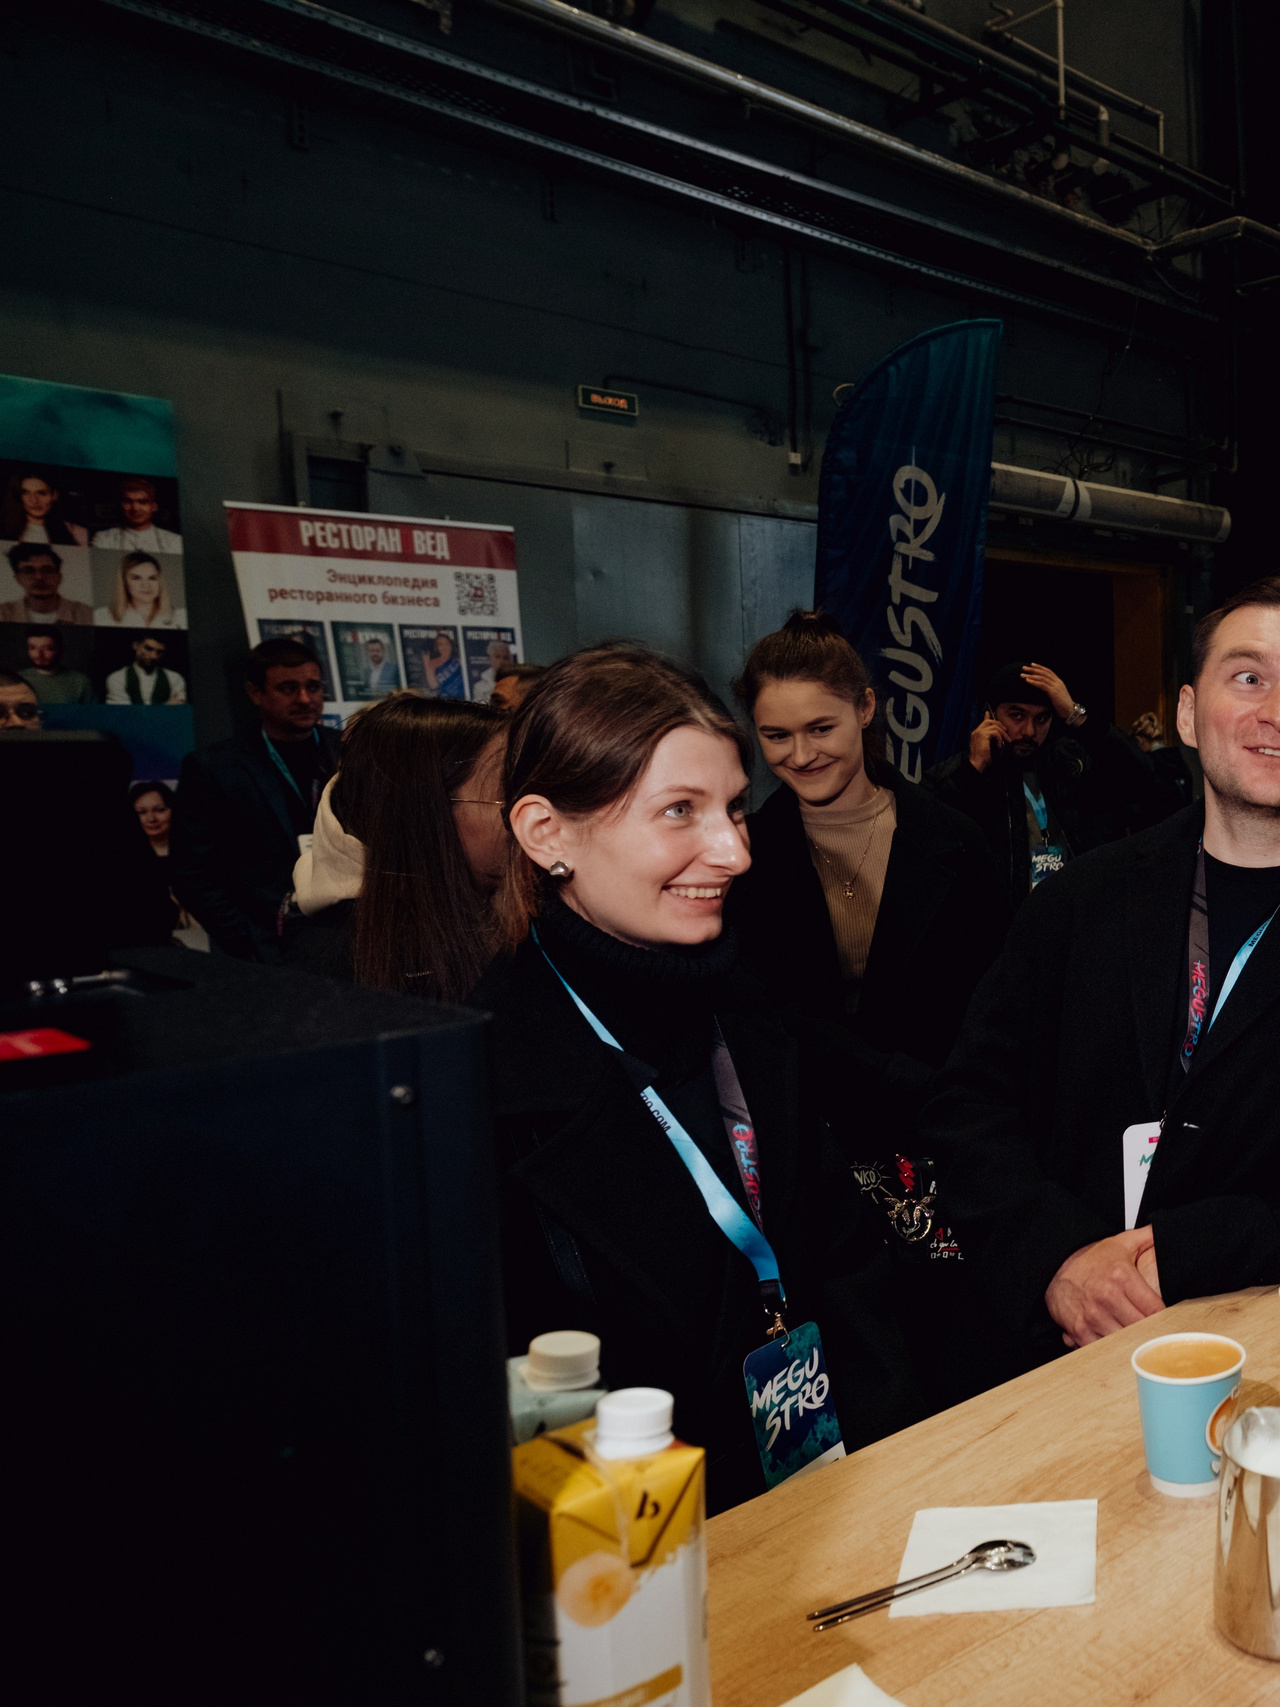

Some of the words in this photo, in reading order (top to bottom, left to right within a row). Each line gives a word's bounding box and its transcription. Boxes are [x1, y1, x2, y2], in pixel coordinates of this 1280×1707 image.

[300, 519, 402, 553] РЕСТОРАН
[413, 530, 450, 560] ВЕД
[326, 569, 438, 590] Энциклопедия
[268, 588, 378, 606] ресторанного
[382, 591, 440, 608] бизнеса
[877, 446, 946, 784] EGUSTRO
[1032, 853, 1062, 863] MEGU
[1034, 862, 1065, 873] STRO
[750, 1347, 819, 1418] MEGU
[765, 1373, 829, 1452] STRO
